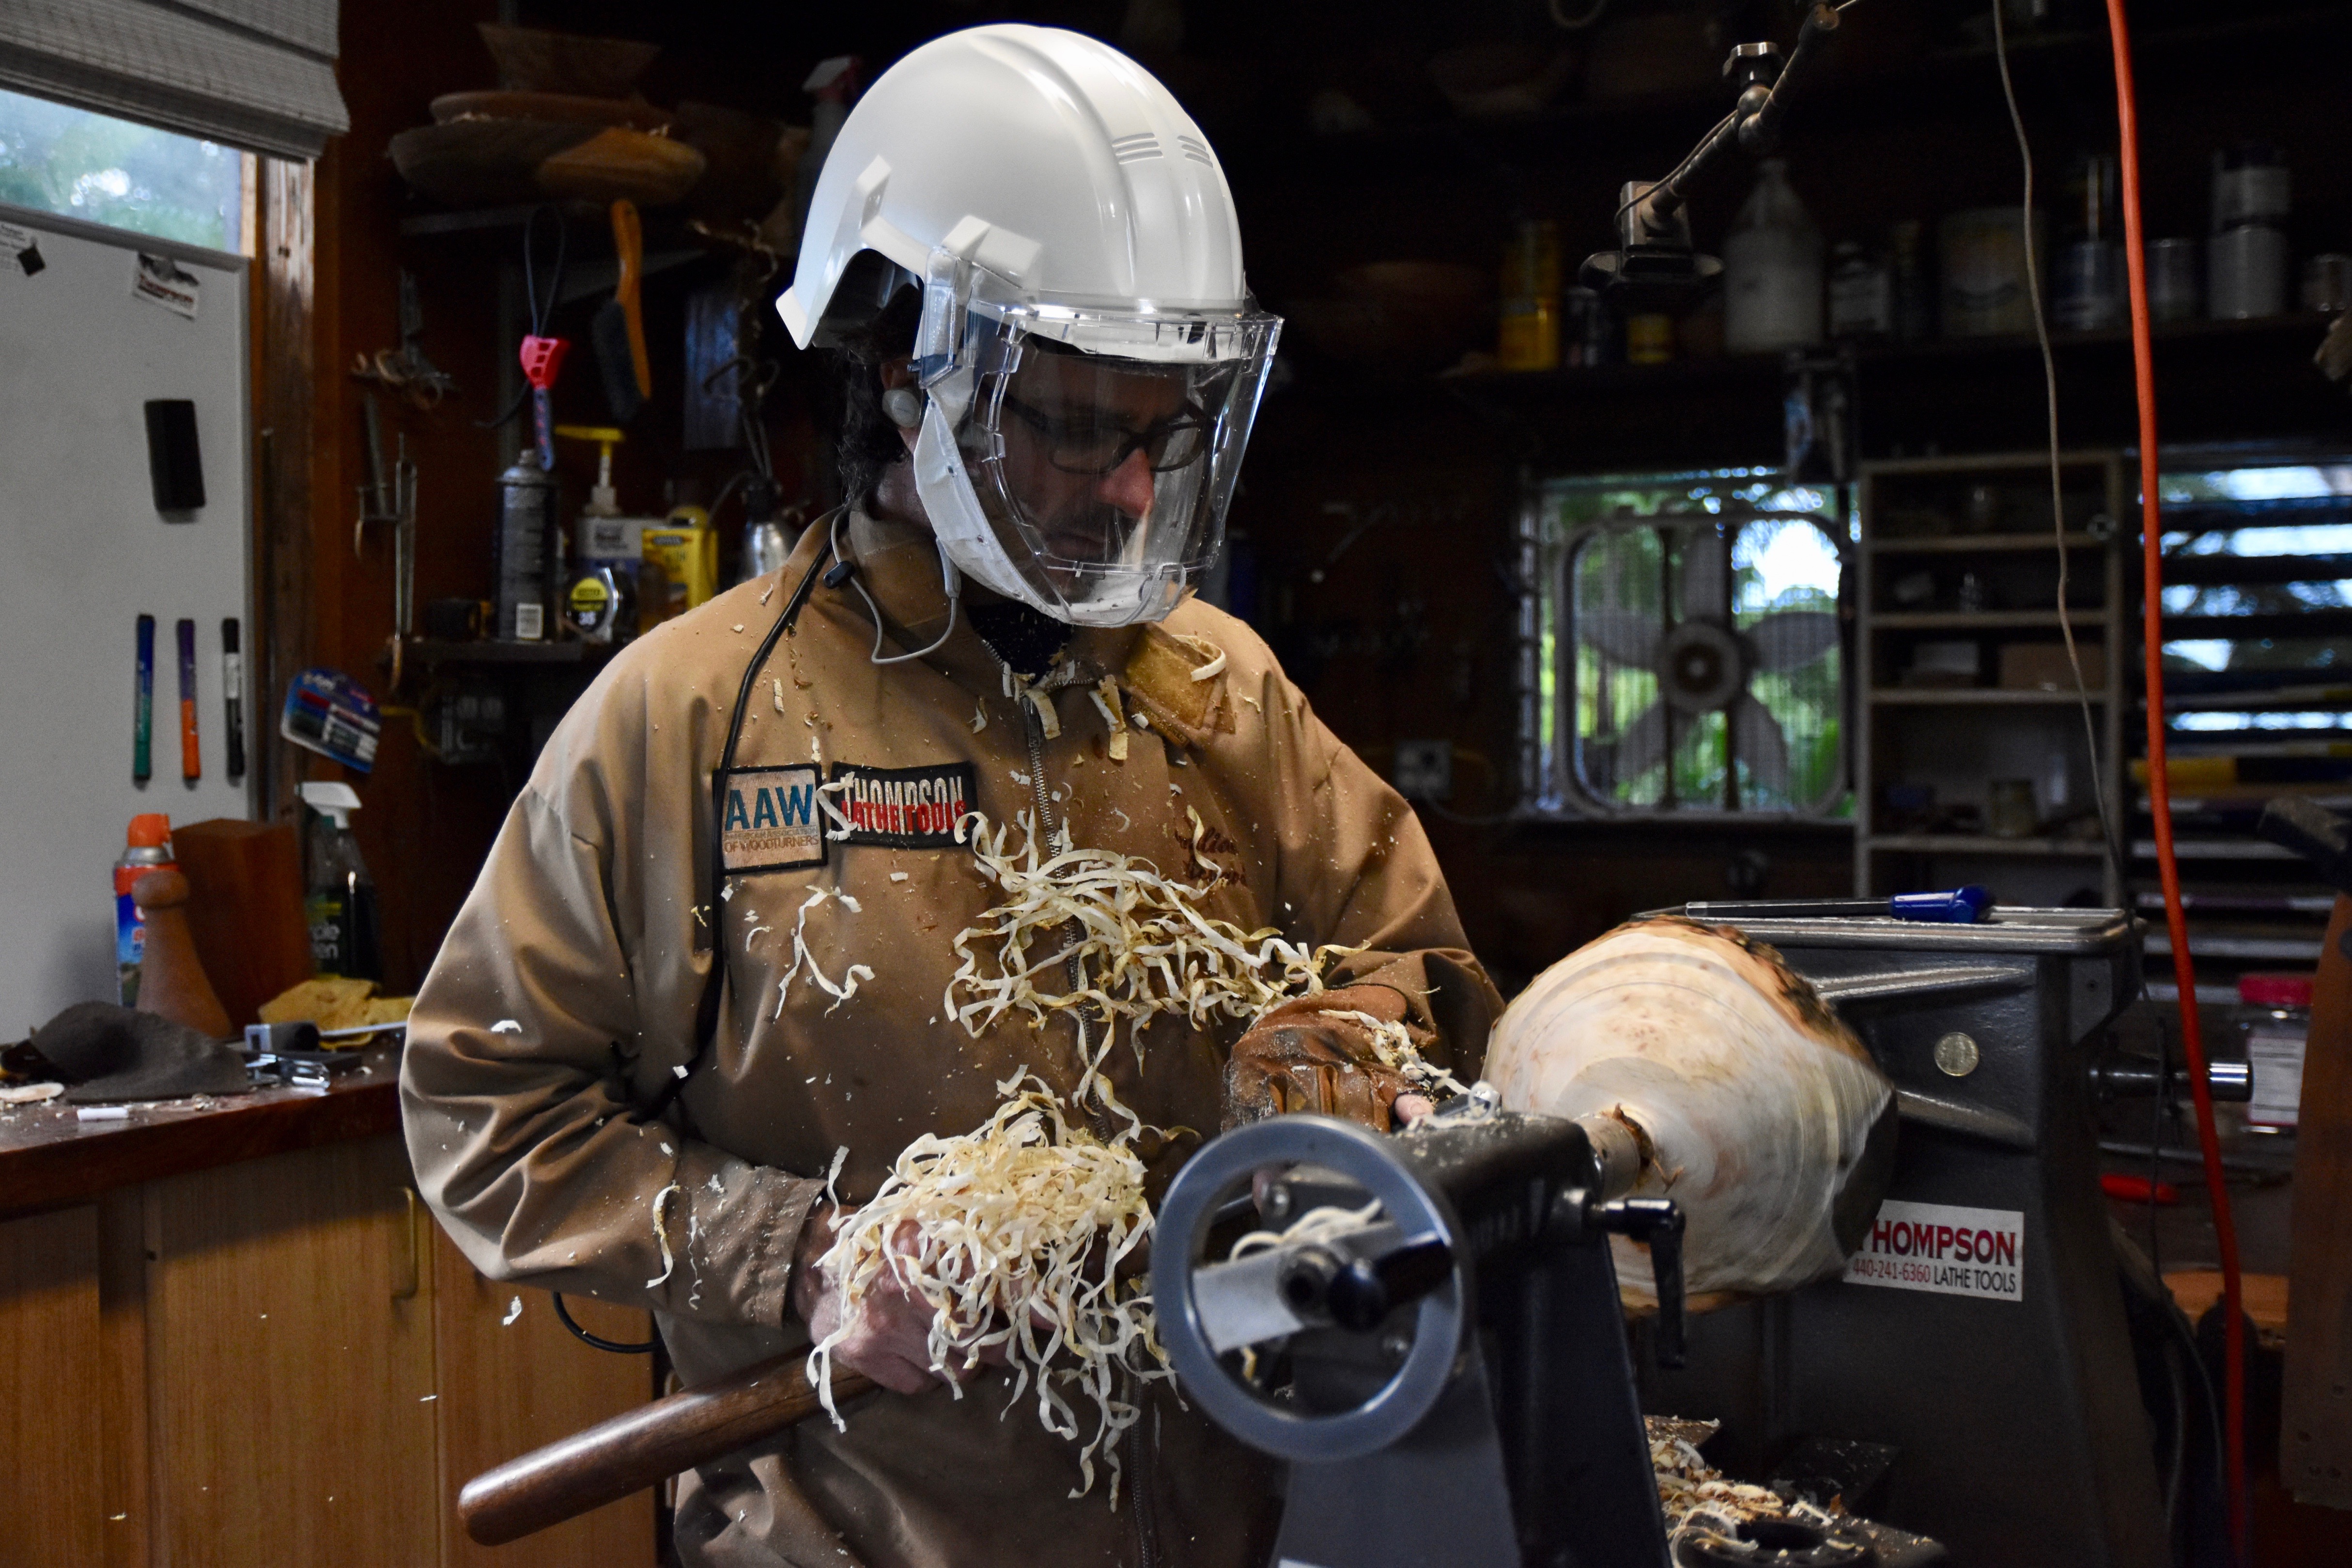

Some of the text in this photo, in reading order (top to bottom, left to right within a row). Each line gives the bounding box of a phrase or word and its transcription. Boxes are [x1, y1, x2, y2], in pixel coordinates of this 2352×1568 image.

[725, 784, 814, 831] AAW
[840, 776, 963, 835] THOMPSON
[1857, 1220, 2015, 1266] HOMPSON
[1934, 1266, 1970, 1288] LATHE
[1976, 1269, 2015, 1293] TOOLS
